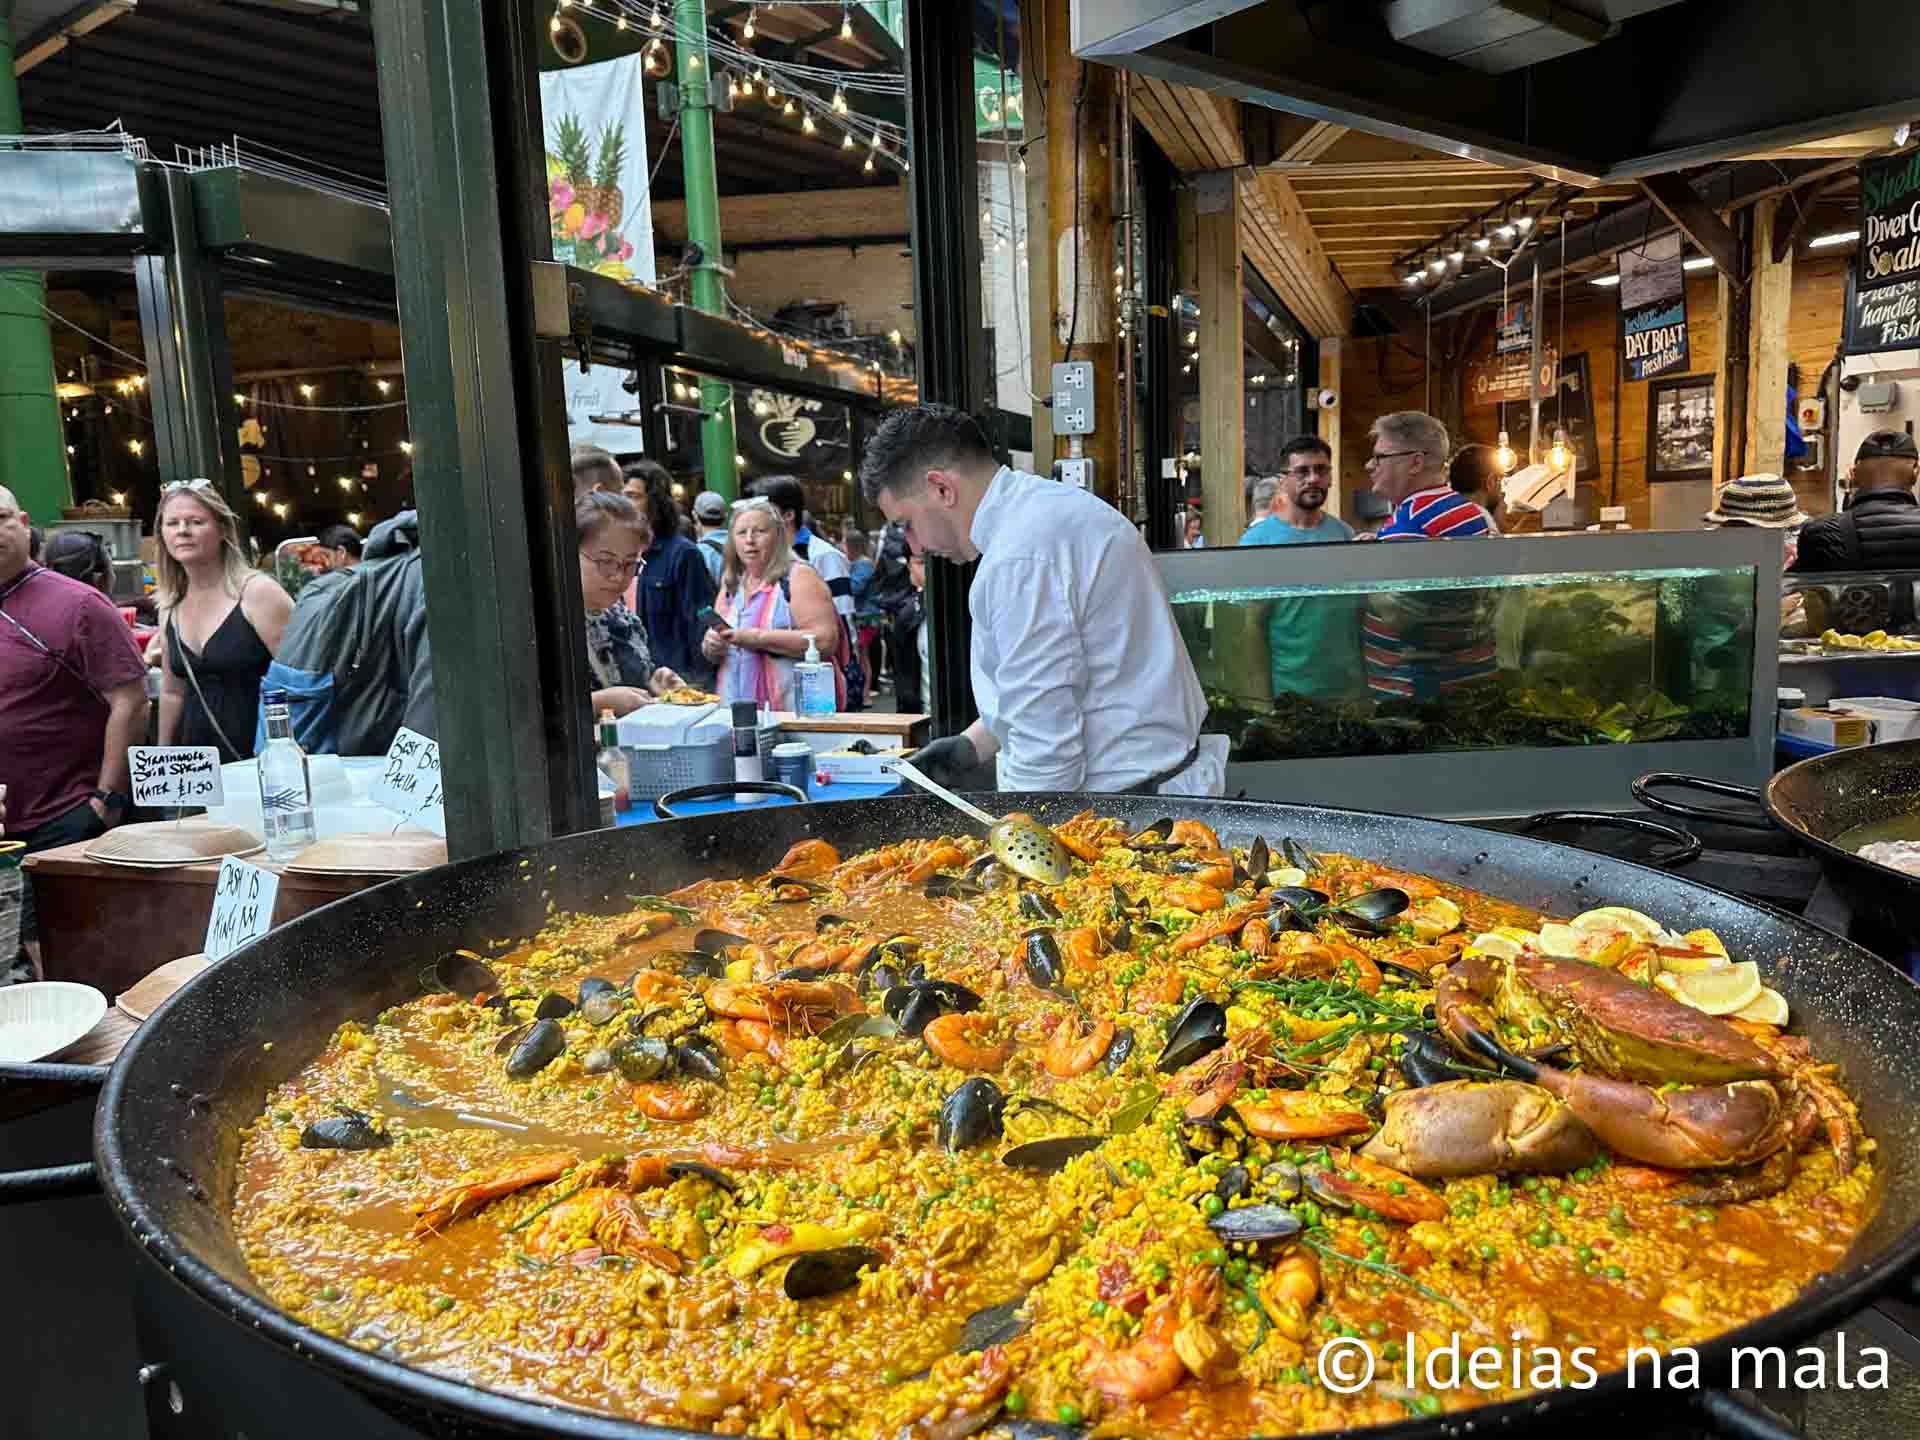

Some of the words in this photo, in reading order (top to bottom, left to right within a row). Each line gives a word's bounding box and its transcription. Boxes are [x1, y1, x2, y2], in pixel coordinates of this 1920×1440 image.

[1866, 212, 1908, 247] Diver
[1860, 294, 1917, 328] handle
[1624, 331, 1650, 359] DAY
[1651, 323, 1686, 353] BOAT
